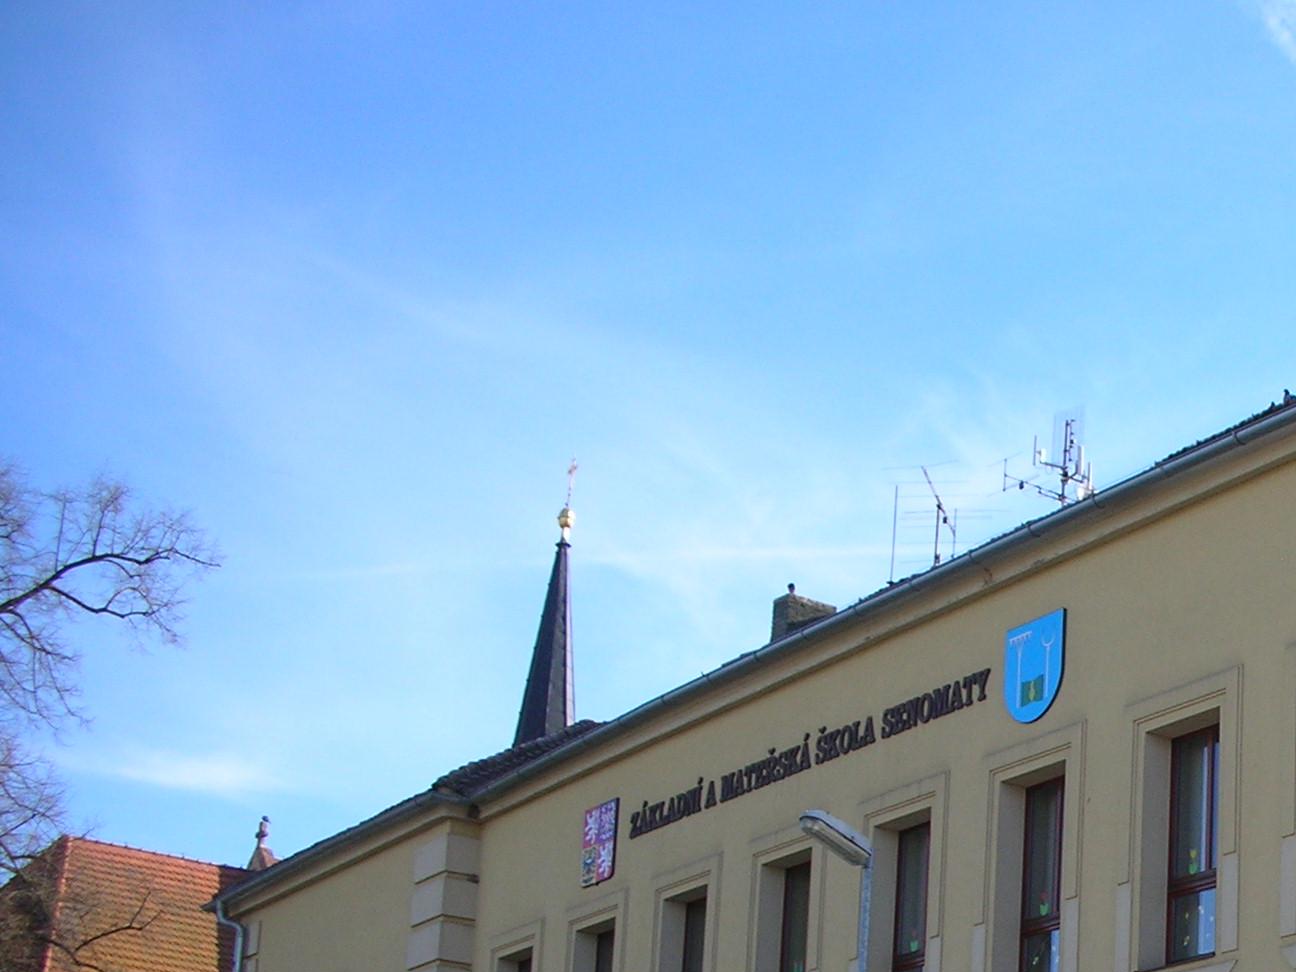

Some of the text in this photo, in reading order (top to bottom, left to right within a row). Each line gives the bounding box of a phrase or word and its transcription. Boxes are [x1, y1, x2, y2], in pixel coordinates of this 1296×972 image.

[629, 667, 991, 839] ZÁKLADNÍ A MATEŘSKÁ ŠKOLA SENOMATY
